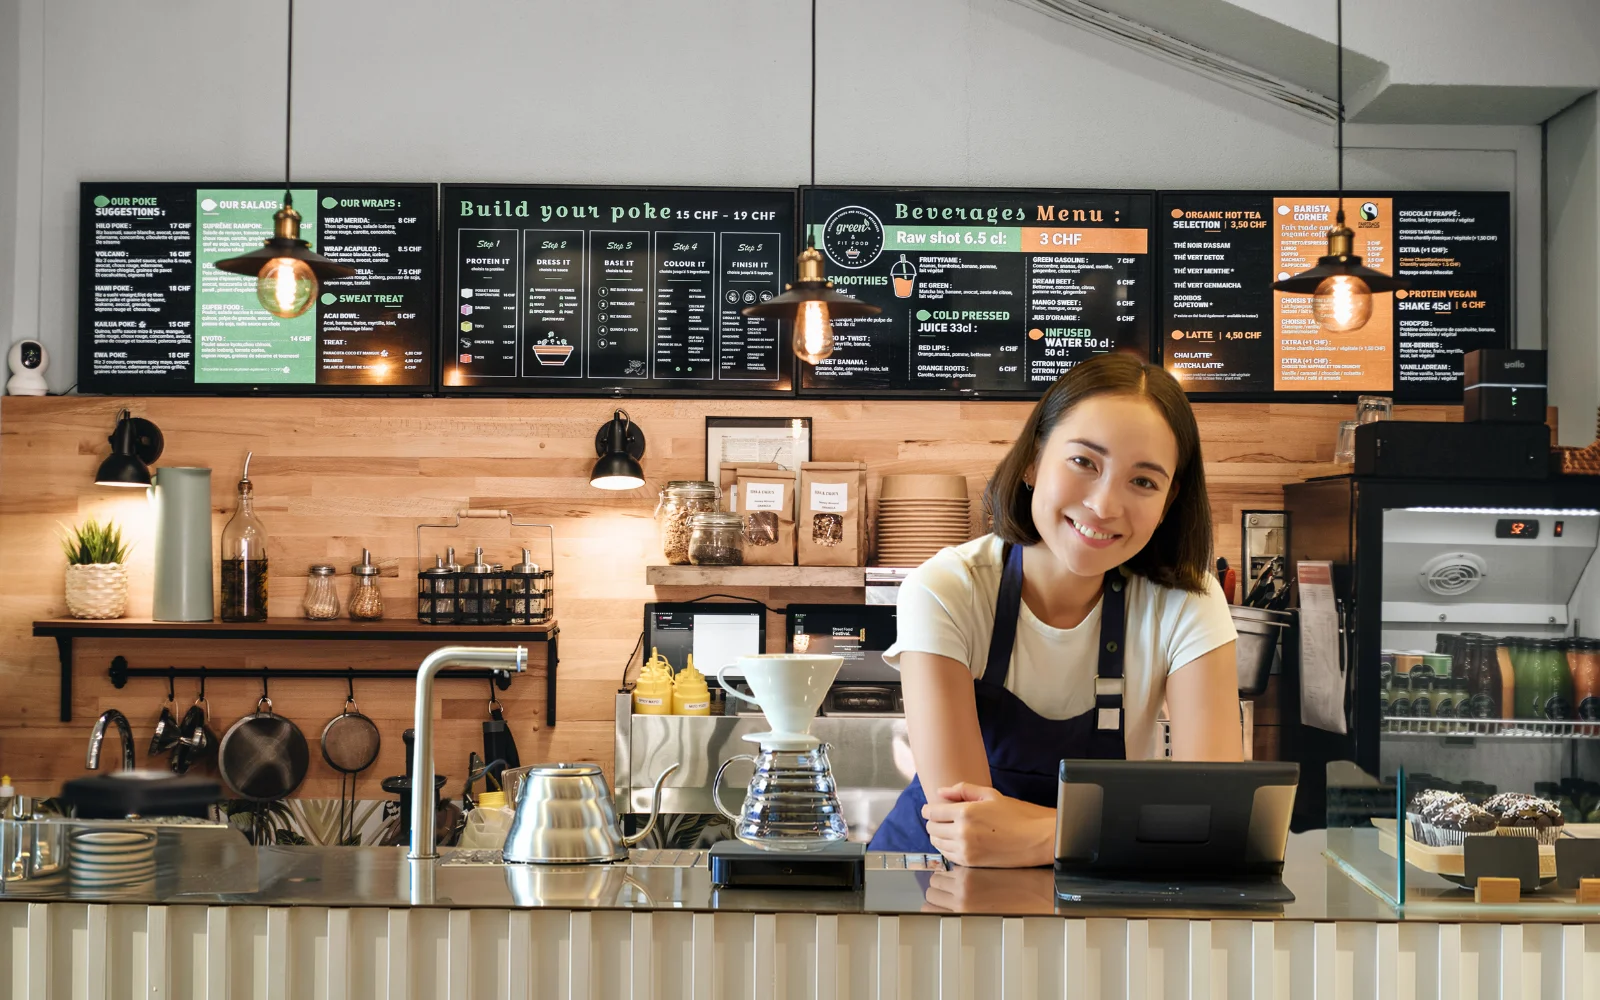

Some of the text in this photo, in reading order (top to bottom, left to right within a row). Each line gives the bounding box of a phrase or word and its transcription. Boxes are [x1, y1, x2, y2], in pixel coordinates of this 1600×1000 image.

[220, 201, 277, 209] OUR SALADS
[96, 208, 160, 216] SUGGESTIONS
[460, 200, 776, 223] Build your poke 15 CHF 19 CHF
[896, 203, 1025, 224] Beverages
[1037, 206, 1104, 221] Menu
[836, 224, 865, 235] green
[1231, 221, 1248, 229] 3,50
[897, 231, 1007, 244] Raw shot 6.5 cl:
[1040, 233, 1082, 245] 3 CHF
[477, 240, 494, 249] Step
[541, 241, 558, 250] Step
[607, 242, 624, 251] Step
[673, 243, 689, 251] Step
[738, 244, 754, 252] Step
[827, 276, 888, 285] SMOOTHIES
[1399, 302, 1430, 310] SHAKE
[1432, 302, 1451, 310] 45cl
[933, 311, 1010, 320] COLD PRESSED
[918, 324, 971, 333] JUICE 33cl
[1046, 328, 1091, 337] INFUSED
[1225, 332, 1243, 340] 4,50
[1045, 338, 1108, 348] WATER 50 cl
[1504, 360, 1525, 369] yallo
